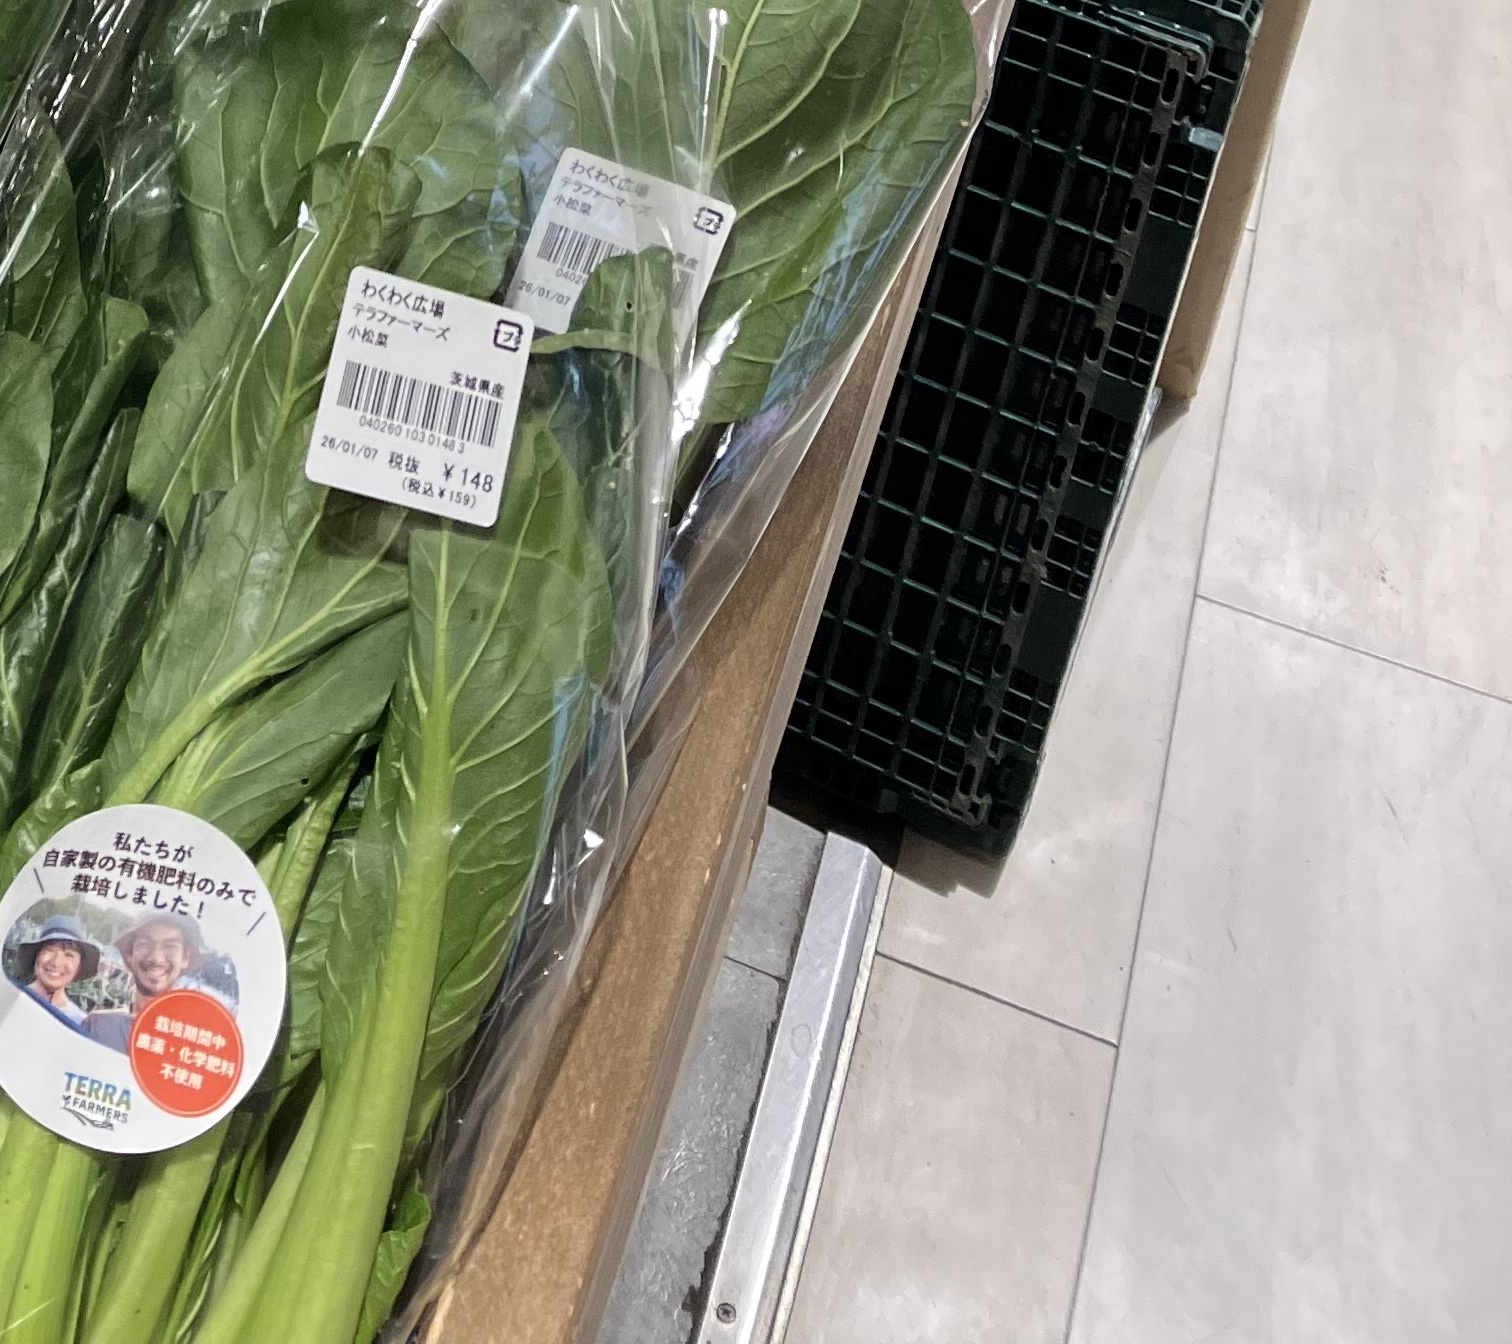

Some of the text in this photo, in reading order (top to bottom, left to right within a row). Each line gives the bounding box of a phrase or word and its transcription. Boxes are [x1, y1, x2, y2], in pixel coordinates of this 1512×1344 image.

[553, 193, 593, 216] 小松菜
[360, 278, 446, 320] わくわく広場
[518, 279, 571, 308] 26/01/07
[347, 324, 390, 349] 小松菜
[351, 303, 451, 342] テラファーマーズ
[450, 370, 505, 401] 茨城県産
[320, 434, 380, 461] 26/01/07
[388, 450, 421, 475] 税抜
[401, 478, 478, 509] (税込¥159)
[113, 831, 194, 863] 私たちが
[41, 848, 257, 908] 自家製の有機肥料のみで
[154, 1014, 227, 1051] 栽培期間中
[63, 1071, 131, 1111] TERRA
[159, 1063, 205, 1092] 不使用
[72, 1096, 129, 1125] FARMERS
